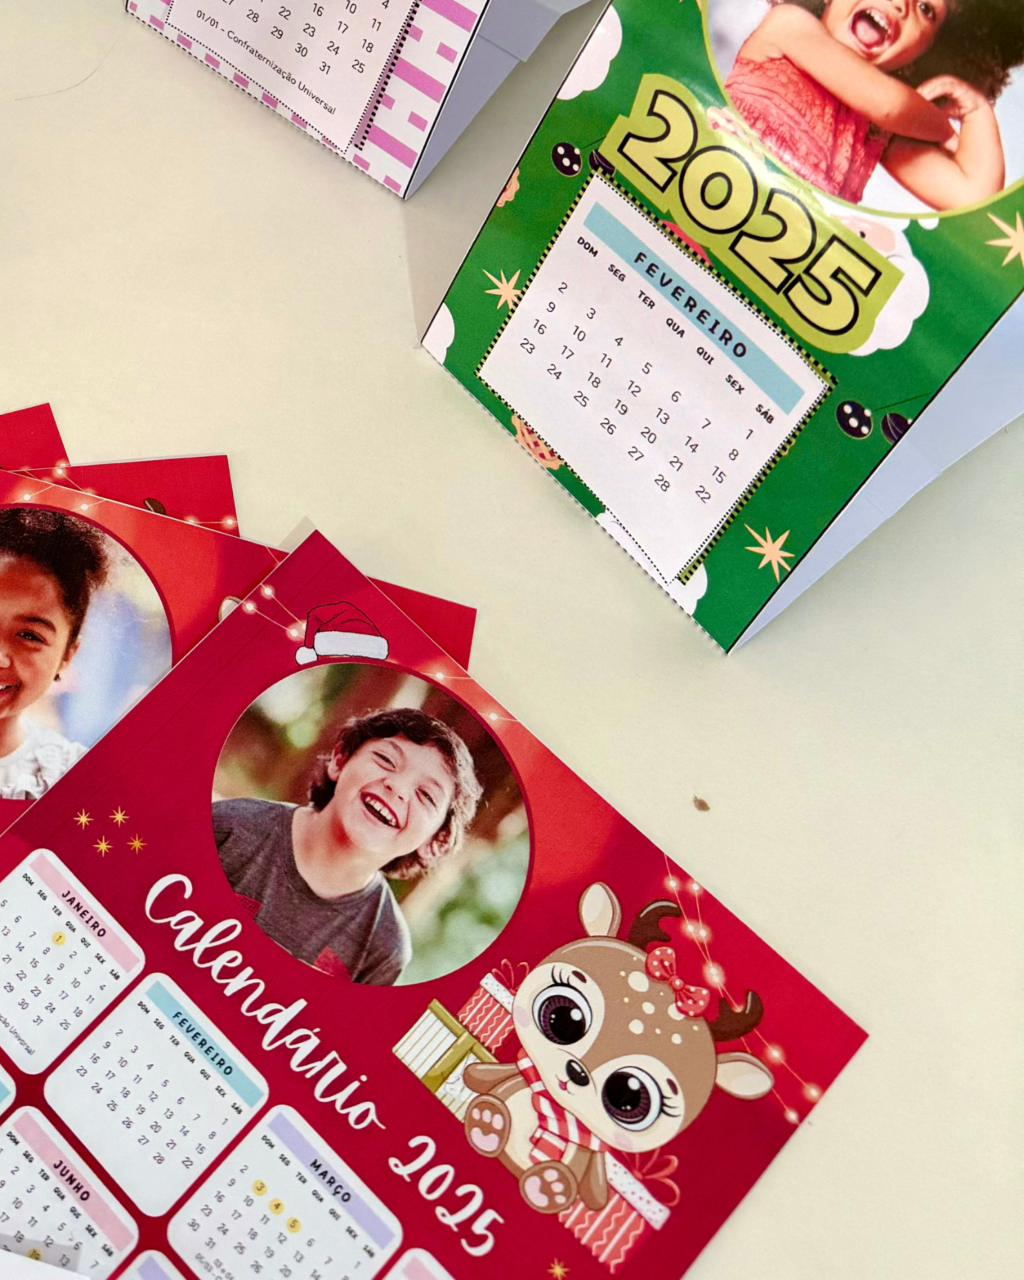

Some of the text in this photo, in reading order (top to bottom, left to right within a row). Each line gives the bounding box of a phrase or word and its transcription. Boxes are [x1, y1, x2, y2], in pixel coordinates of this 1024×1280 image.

[313, 3, 324, 17] 16
[338, 21, 349, 34] 17
[362, 39, 374, 53] 18
[346, 0, 357, 14] 10
[372, 18, 382, 32] 11
[382, 0, 390, 10] 4
[195, 9, 219, 29] 01/01
[226, 29, 296, 85] Confraternização
[297, 82, 336, 115] Universal
[617, 89, 882, 336] 2025
[577, 236, 774, 424] DOM SEG TER QUA QUI SEX SÁB
[633, 251, 748, 359] FEVEREIRO
[558, 282, 739, 461] 2 3 4 5 6 7 8
[746, 429, 754, 440] 1
[61, 889, 106, 938] JANEIRO
[145, 873, 386, 1130] Calendário
[172, 1011, 233, 1076] FEVEREIRO
[53, 1159, 91, 1202] JUNHO
[309, 1158, 352, 1204] MARÇO
[388, 1135, 505, 1257] 2025
